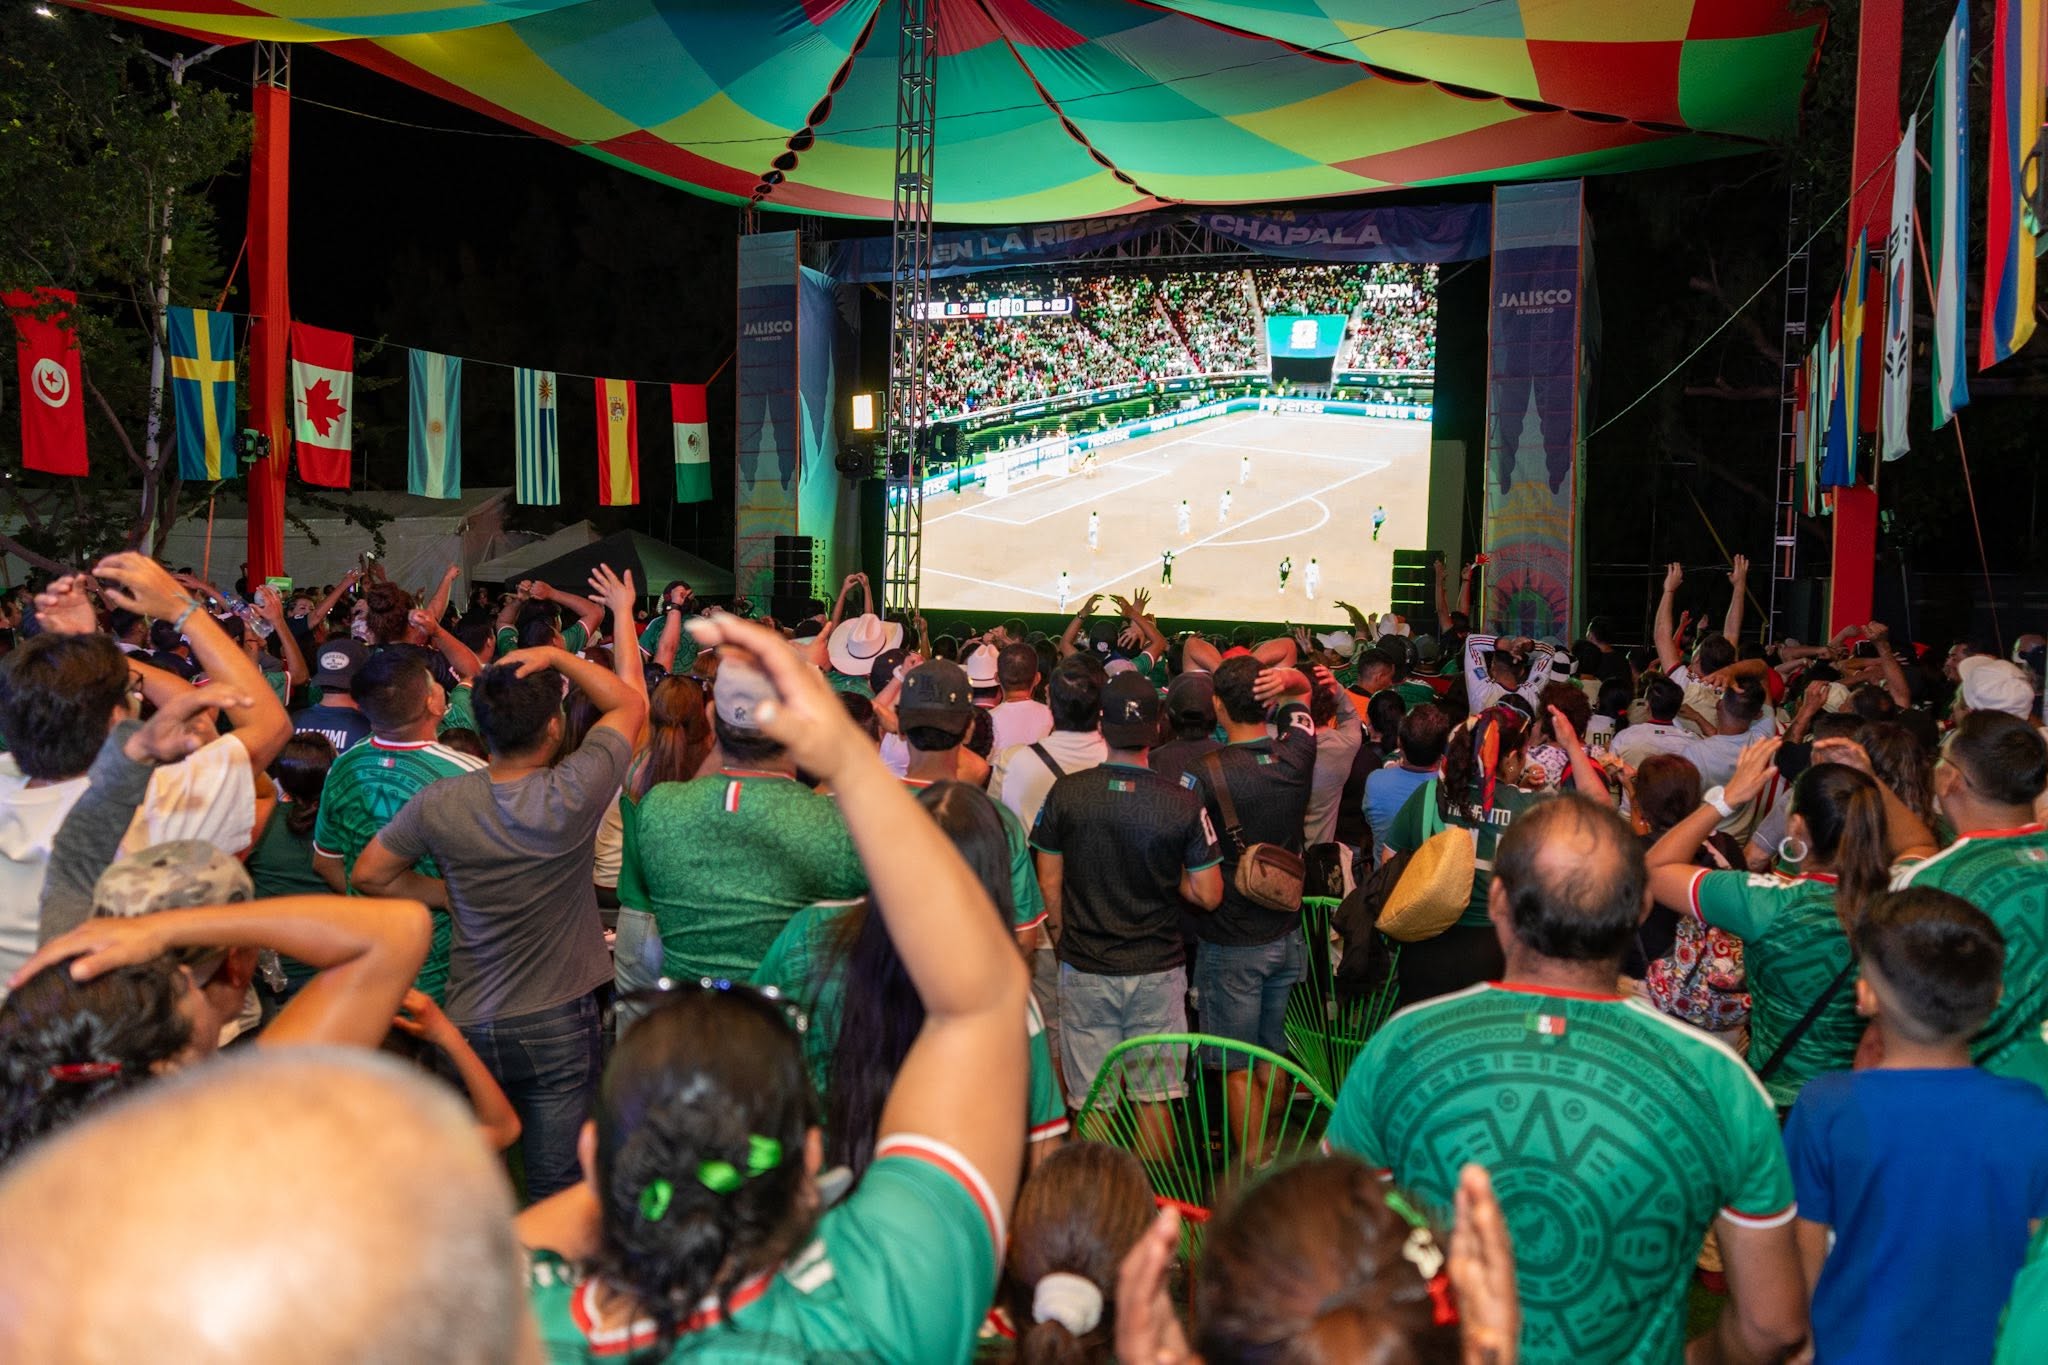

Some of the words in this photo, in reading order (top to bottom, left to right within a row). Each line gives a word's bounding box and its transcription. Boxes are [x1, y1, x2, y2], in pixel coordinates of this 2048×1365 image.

[1209, 214, 1383, 245] CHAPALA
[932, 239, 973, 263] EN
[981, 232, 1026, 255] LA
[1362, 283, 1413, 299] TUDN
[1499, 289, 1572, 307] JALISCO
[744, 320, 793, 335] JALISCO
